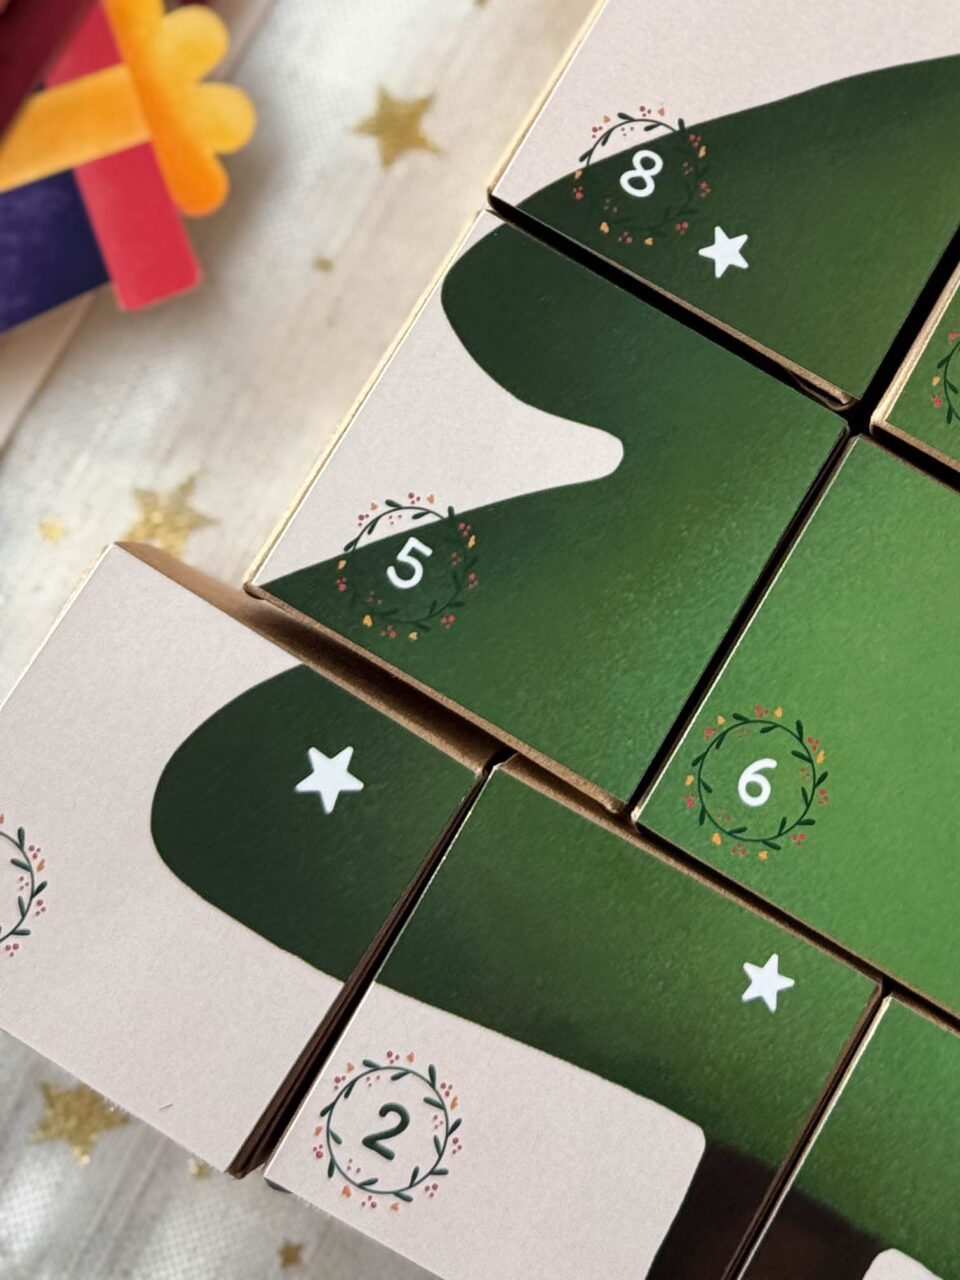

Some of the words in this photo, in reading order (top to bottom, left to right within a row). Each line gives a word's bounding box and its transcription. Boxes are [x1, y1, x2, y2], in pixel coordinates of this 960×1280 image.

[619, 149, 664, 198] 8
[386, 536, 433, 589] 5
[737, 757, 778, 807] 6
[361, 1103, 410, 1161] 2
